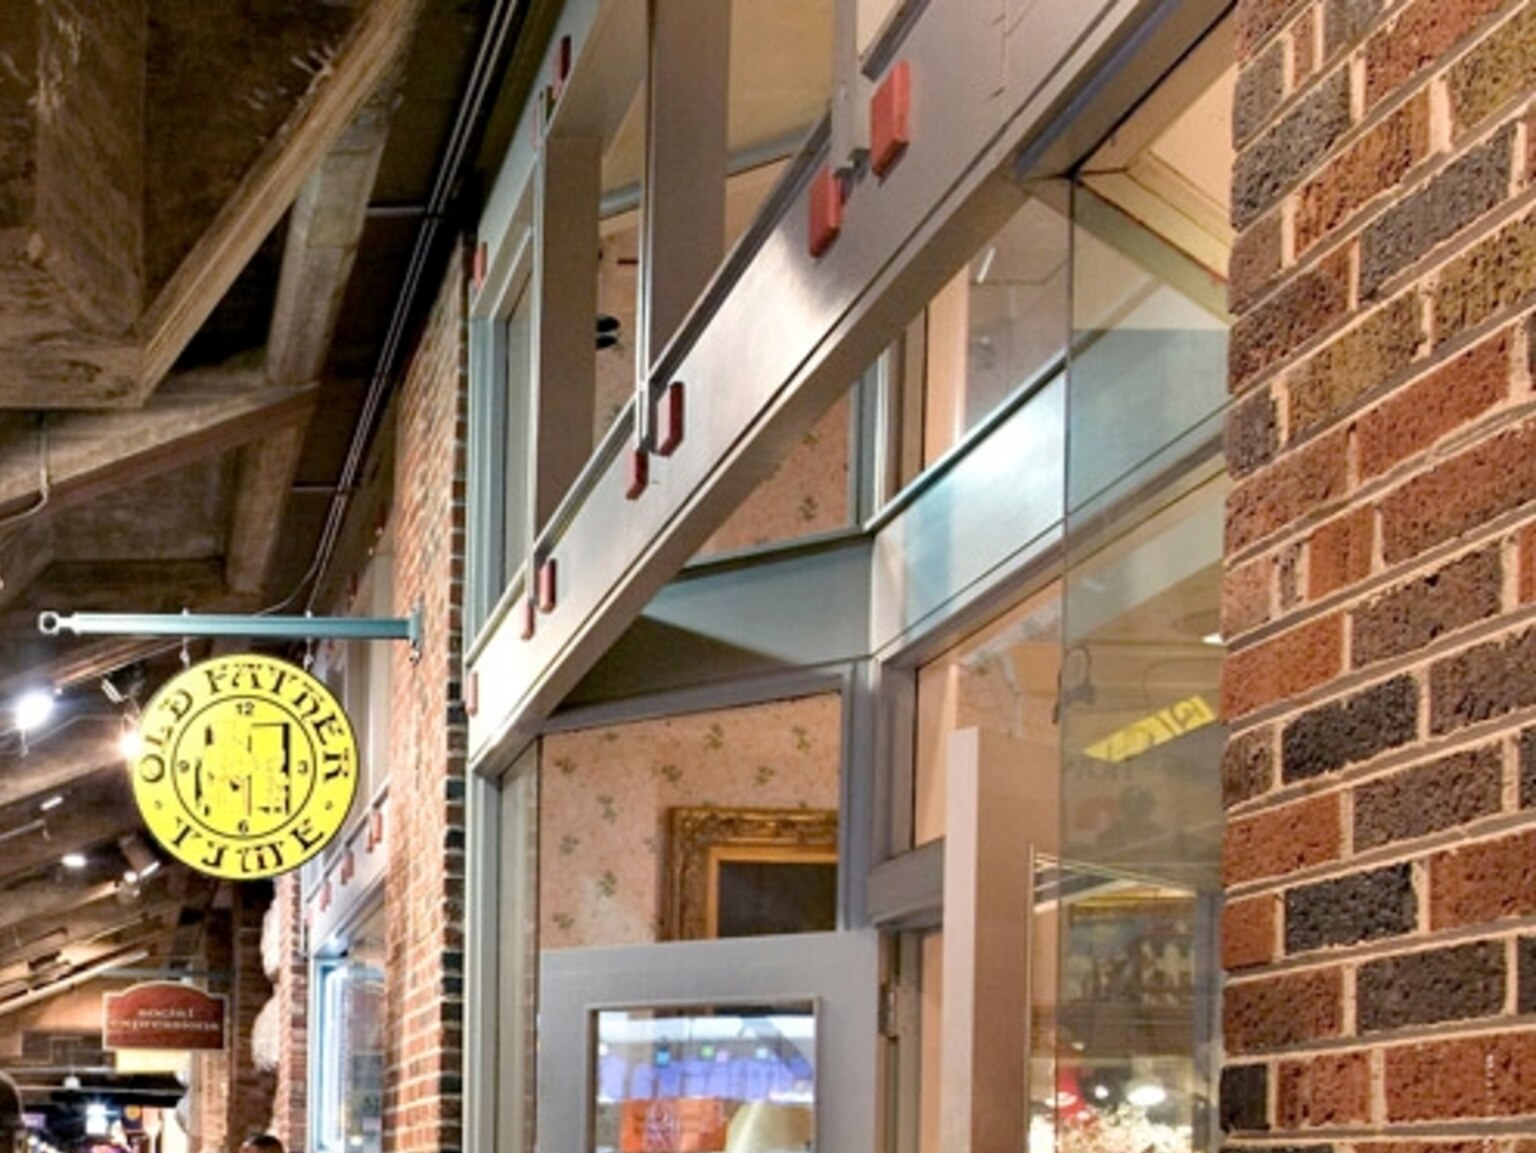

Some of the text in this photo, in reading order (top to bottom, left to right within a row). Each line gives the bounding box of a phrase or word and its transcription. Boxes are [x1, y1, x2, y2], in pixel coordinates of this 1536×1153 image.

[141, 663, 351, 783] OLD FATHER
[235, 702, 255, 716] 12
[237, 819, 249, 835] 6
[171, 818, 324, 874] TIME
